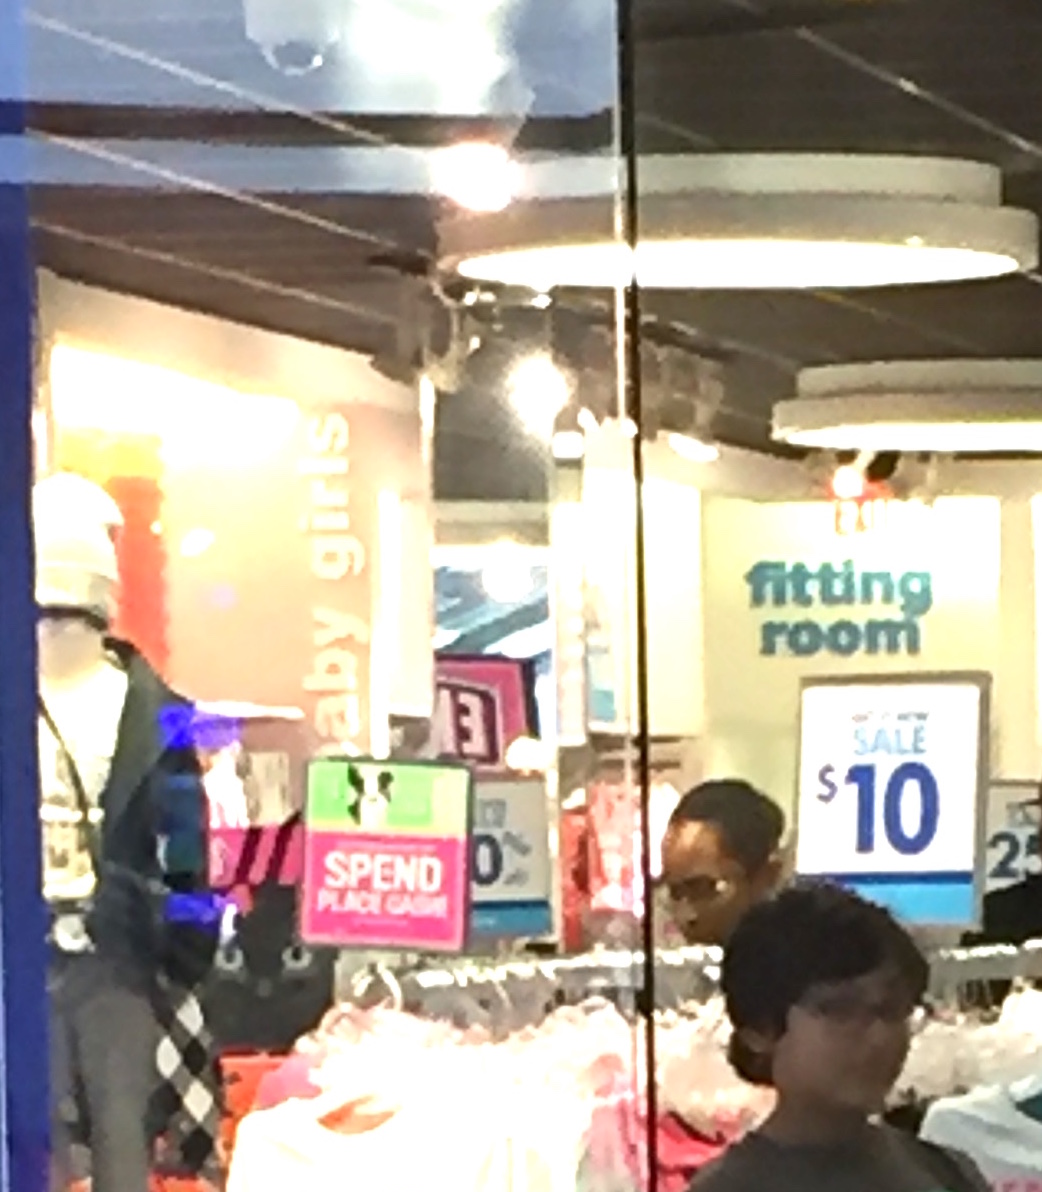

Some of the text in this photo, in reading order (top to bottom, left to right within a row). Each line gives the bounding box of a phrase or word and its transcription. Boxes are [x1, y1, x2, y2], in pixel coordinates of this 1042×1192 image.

[300, 411, 369, 756] aby girls
[743, 559, 934, 617] fitting
[759, 618, 922, 657] room
[853, 723, 928, 757] SALE
[816, 761, 940, 856] $10
[324, 850, 444, 893] SPEND
[317, 888, 382, 915] PLACE
